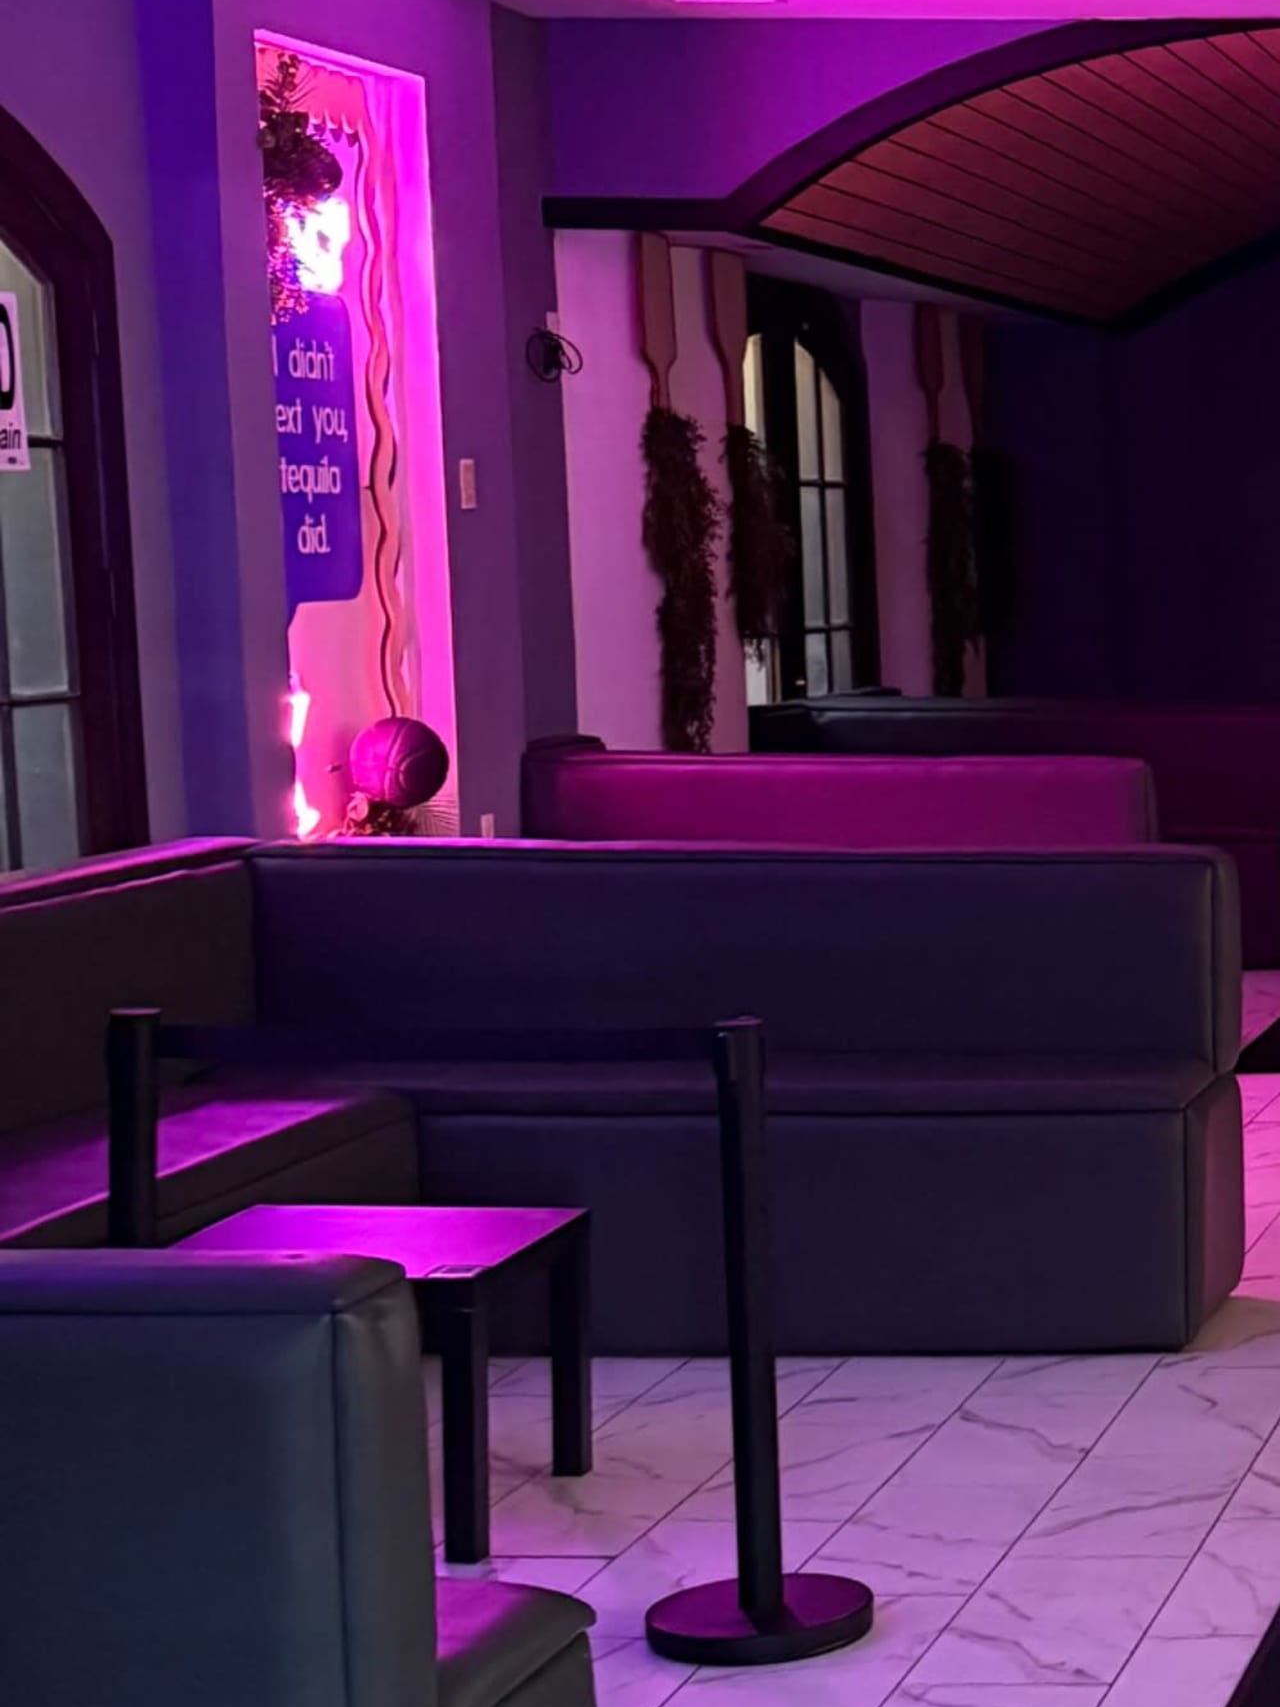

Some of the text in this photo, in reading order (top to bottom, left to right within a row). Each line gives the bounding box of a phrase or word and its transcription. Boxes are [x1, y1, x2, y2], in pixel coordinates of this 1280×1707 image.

[289, 338, 334, 382] didn't
[312, 405, 348, 444] you,
[297, 512, 331, 554] did.
